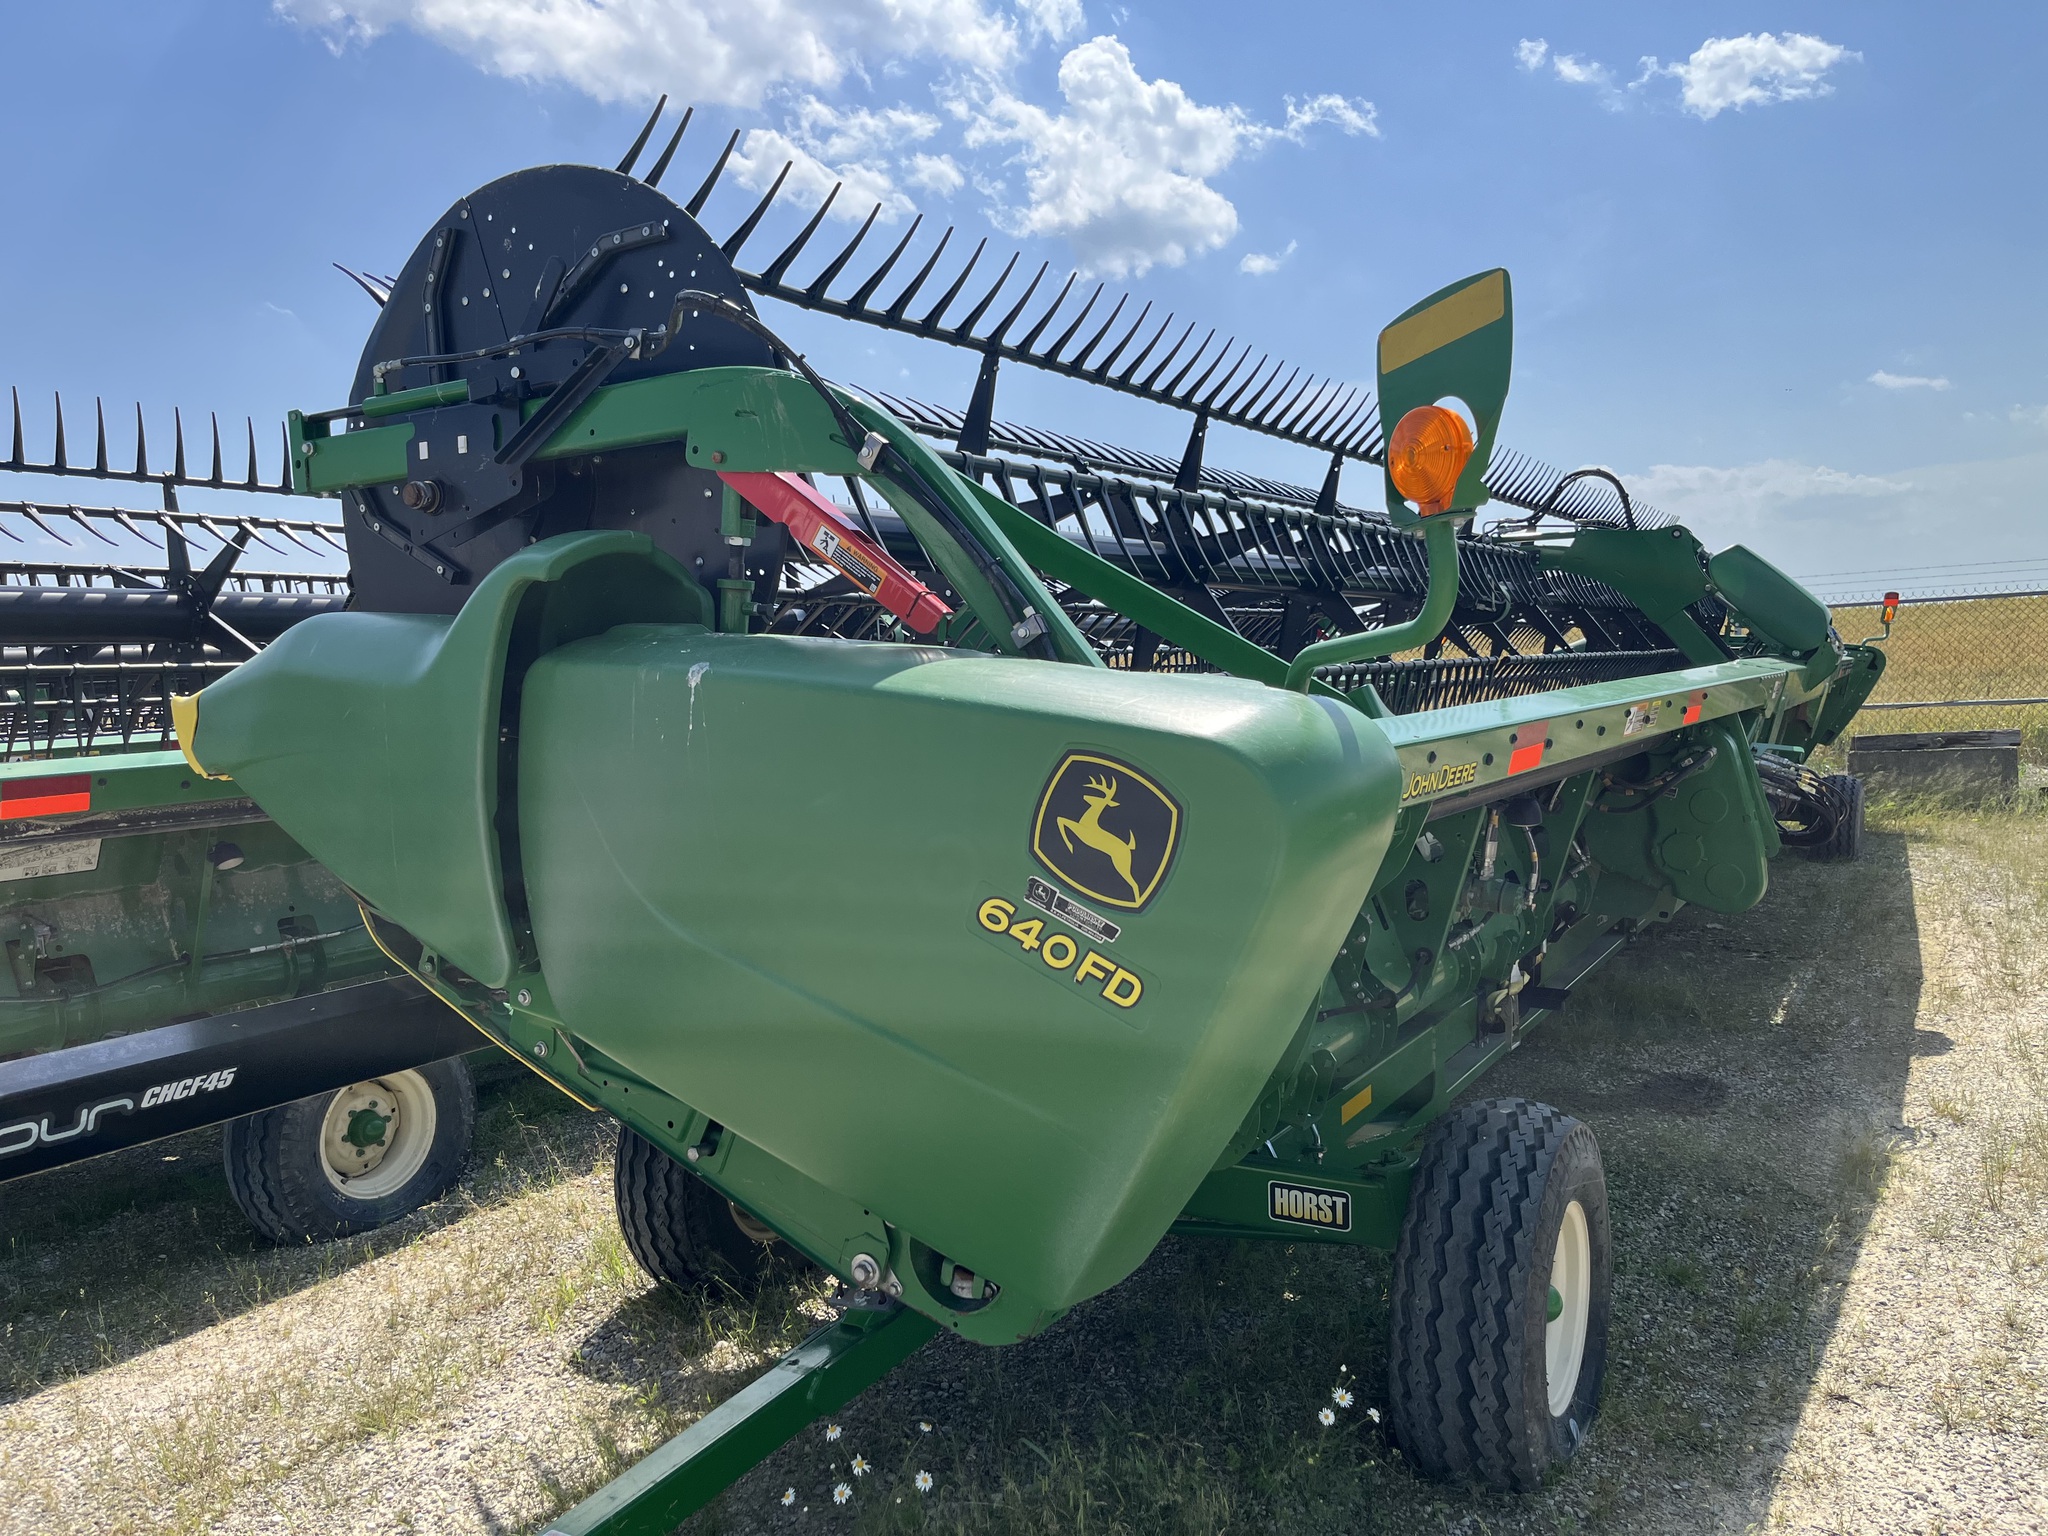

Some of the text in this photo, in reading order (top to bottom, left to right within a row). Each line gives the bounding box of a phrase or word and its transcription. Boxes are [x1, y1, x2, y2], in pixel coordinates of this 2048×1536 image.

[853, 549, 879, 572] WARNING
[1402, 761, 1477, 800] JOHN DEERE
[977, 898, 1142, 1008] 640 FD
[141, 1067, 238, 1108] CHCF45
[1274, 1187, 1346, 1225] HORST
